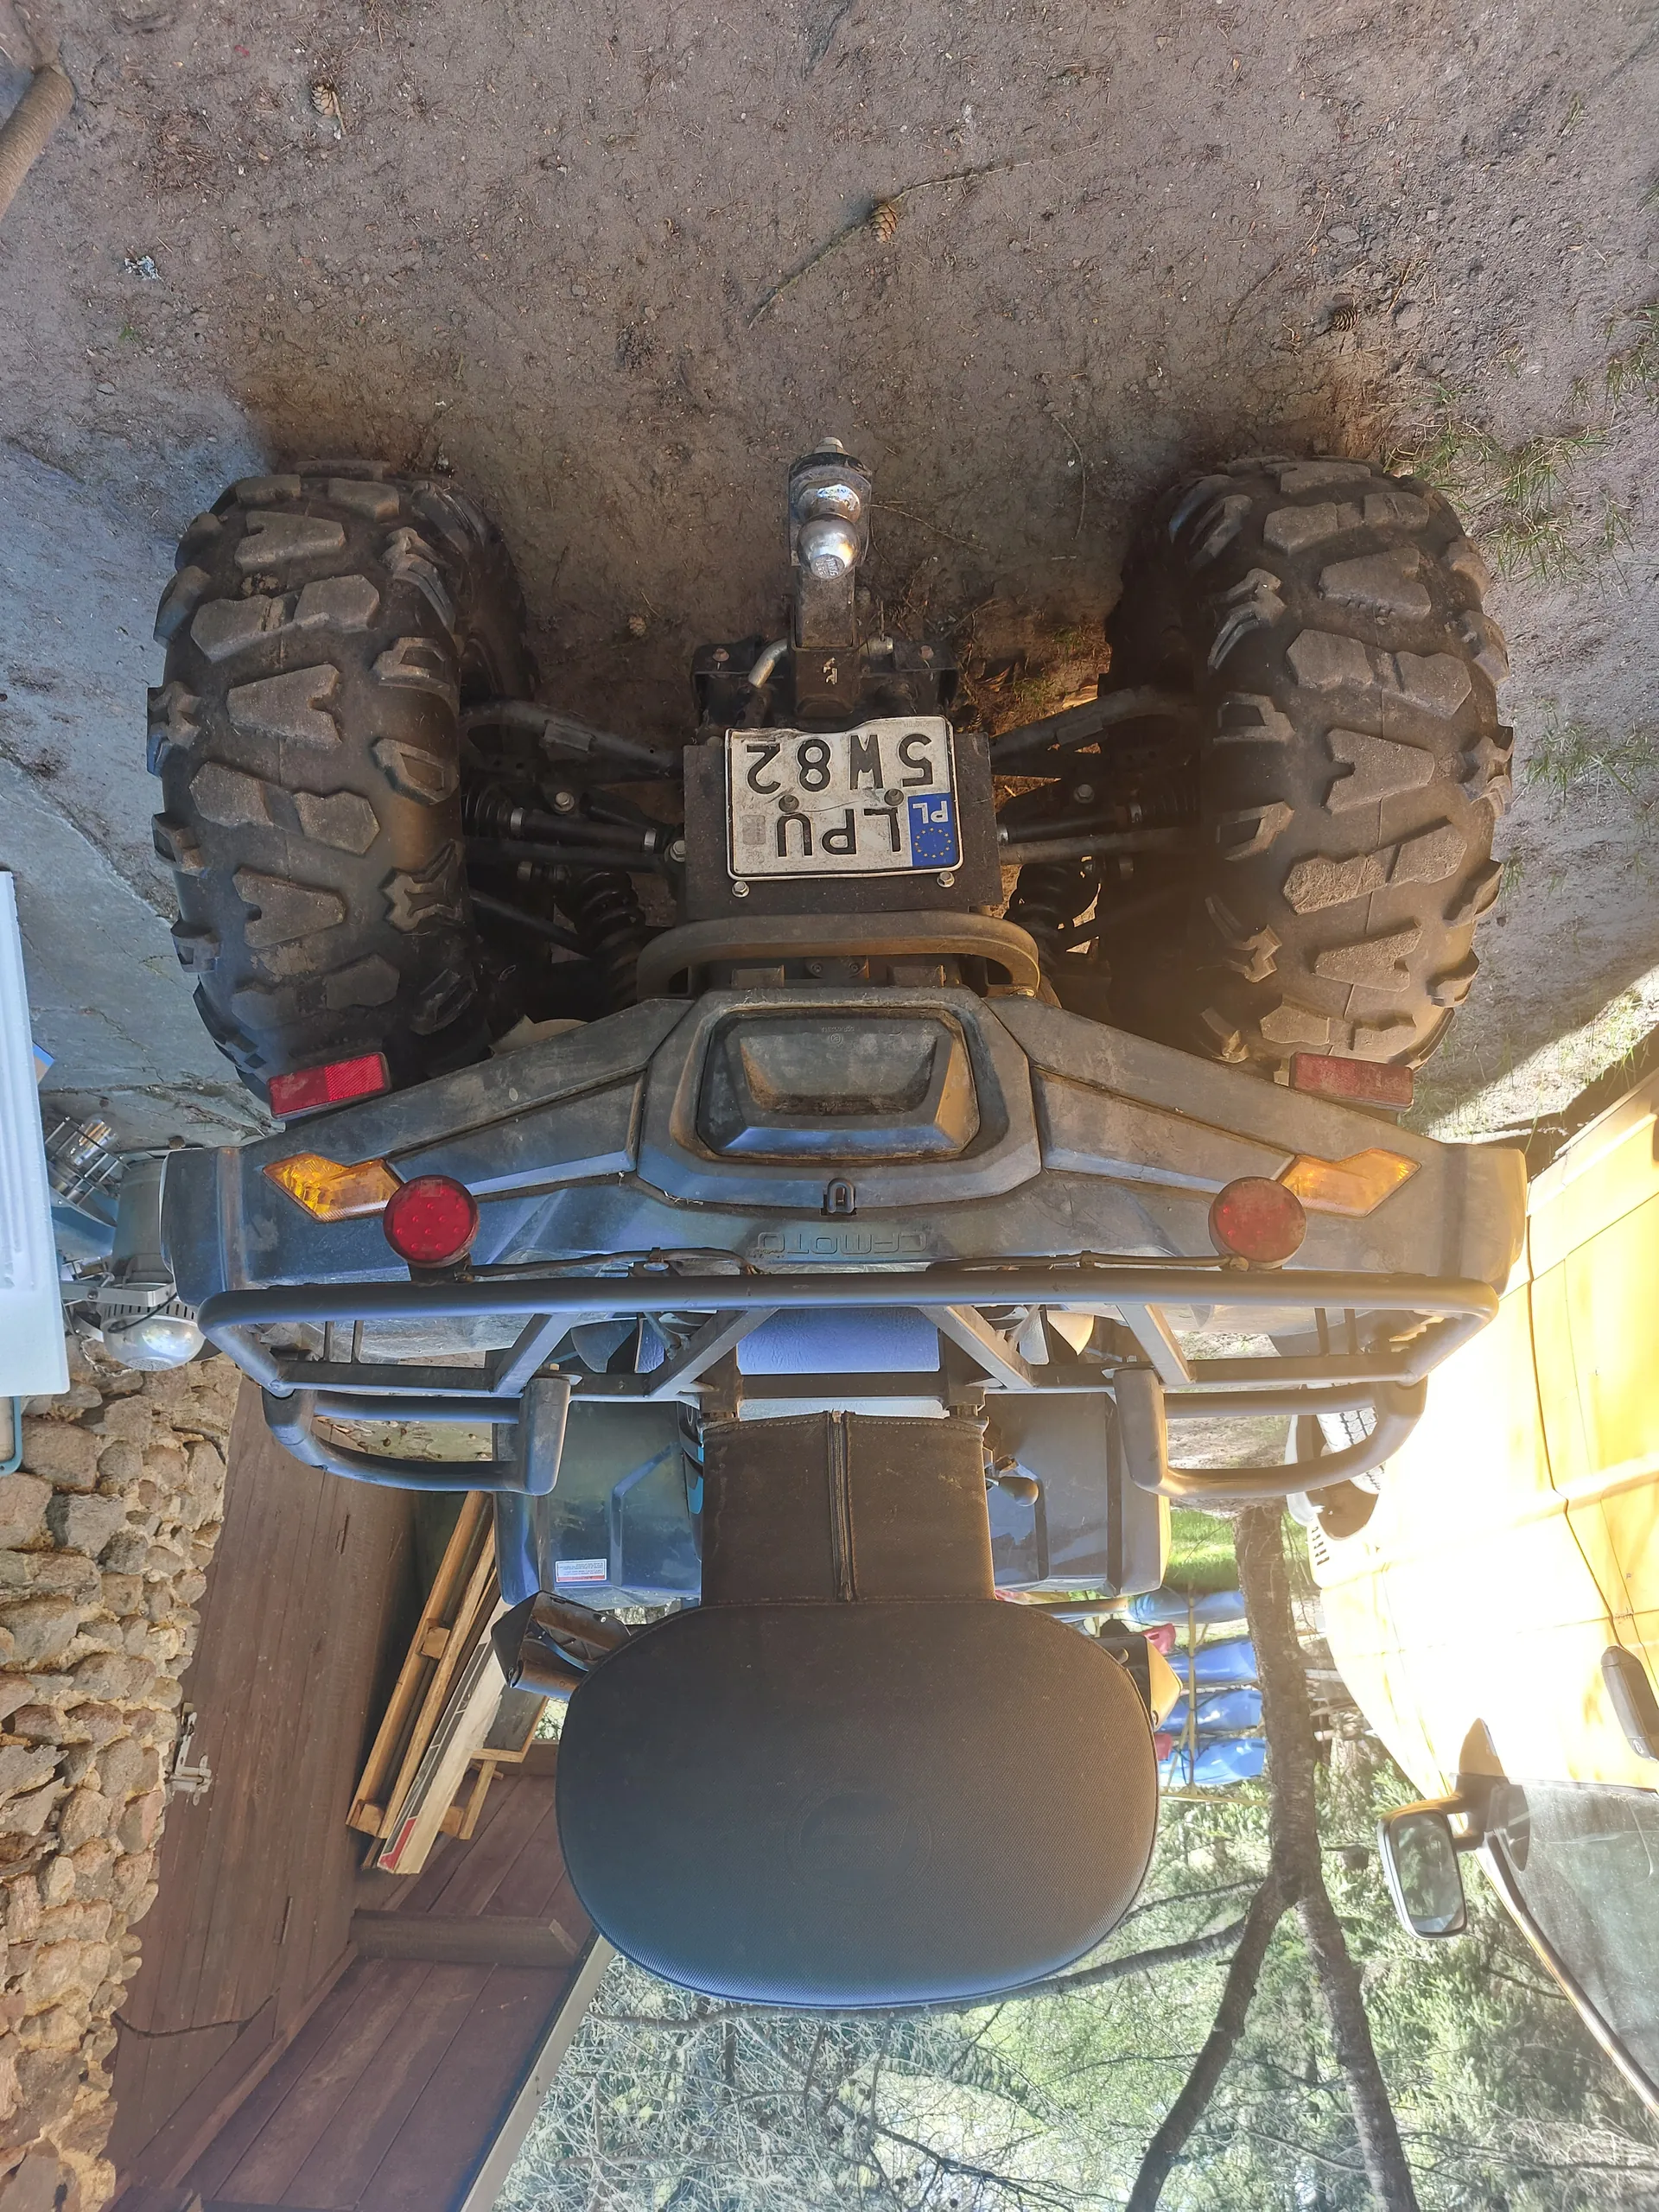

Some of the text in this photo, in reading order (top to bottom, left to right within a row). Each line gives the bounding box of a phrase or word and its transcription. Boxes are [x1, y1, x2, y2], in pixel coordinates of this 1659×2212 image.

[747, 733, 934, 794] 5W82
[912, 800, 949, 823] PL
[777, 808, 901, 858] LPU
[757, 1230, 928, 1255] CFMOTO
